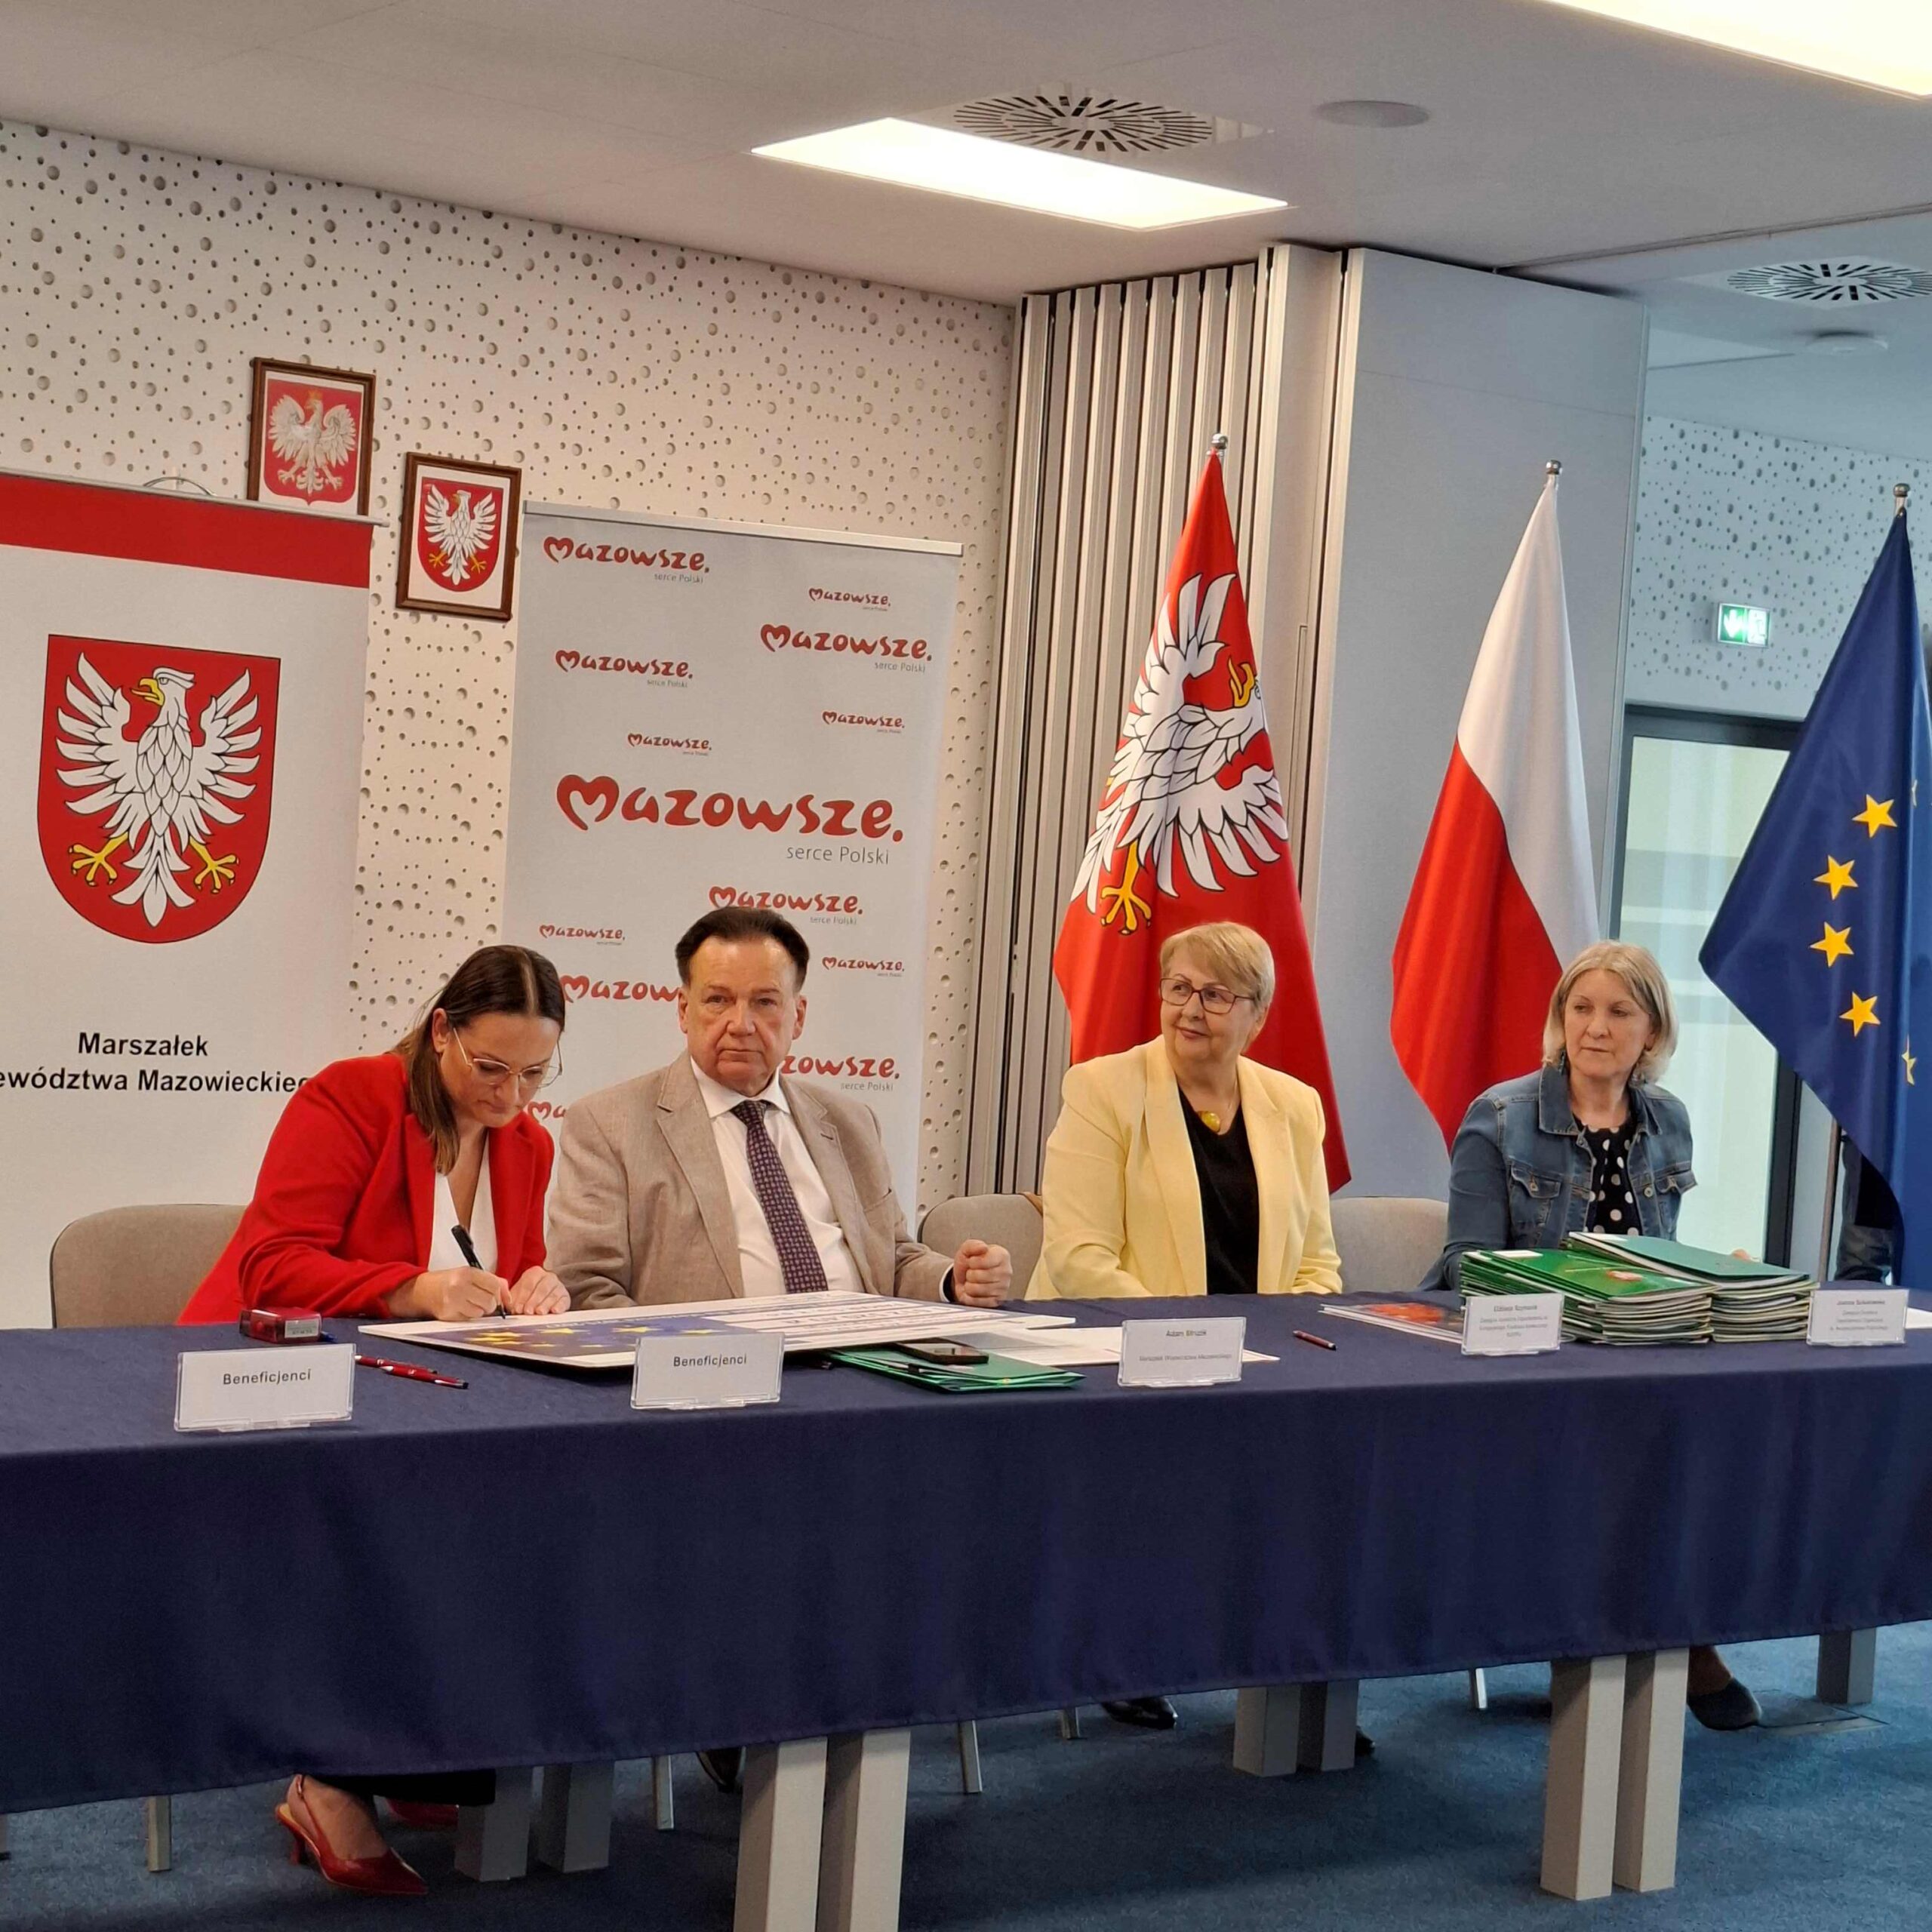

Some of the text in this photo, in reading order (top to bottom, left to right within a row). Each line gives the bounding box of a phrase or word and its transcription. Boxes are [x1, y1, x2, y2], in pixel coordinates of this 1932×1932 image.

[543, 536, 710, 574] Mazowsze.
[678, 574, 703, 583] Polski
[760, 623, 932, 662] Mazowsze.
[555, 650, 694, 679] Mazowsze.
[900, 662, 926, 673] Polski
[556, 774, 903, 842] Mazowsze.
[786, 846, 890, 865] serce Polski
[560, 974, 679, 1003] Mazow
[78, 1032, 209, 1057] Marszałek
[780, 1055, 900, 1079] zowsze.
[138, 1069, 309, 1093] Mazowieckie
[868, 1082, 894, 1091] Polski
[673, 1353, 747, 1367] Beneficjenci
[223, 1368, 312, 1386] Beneficjenci
